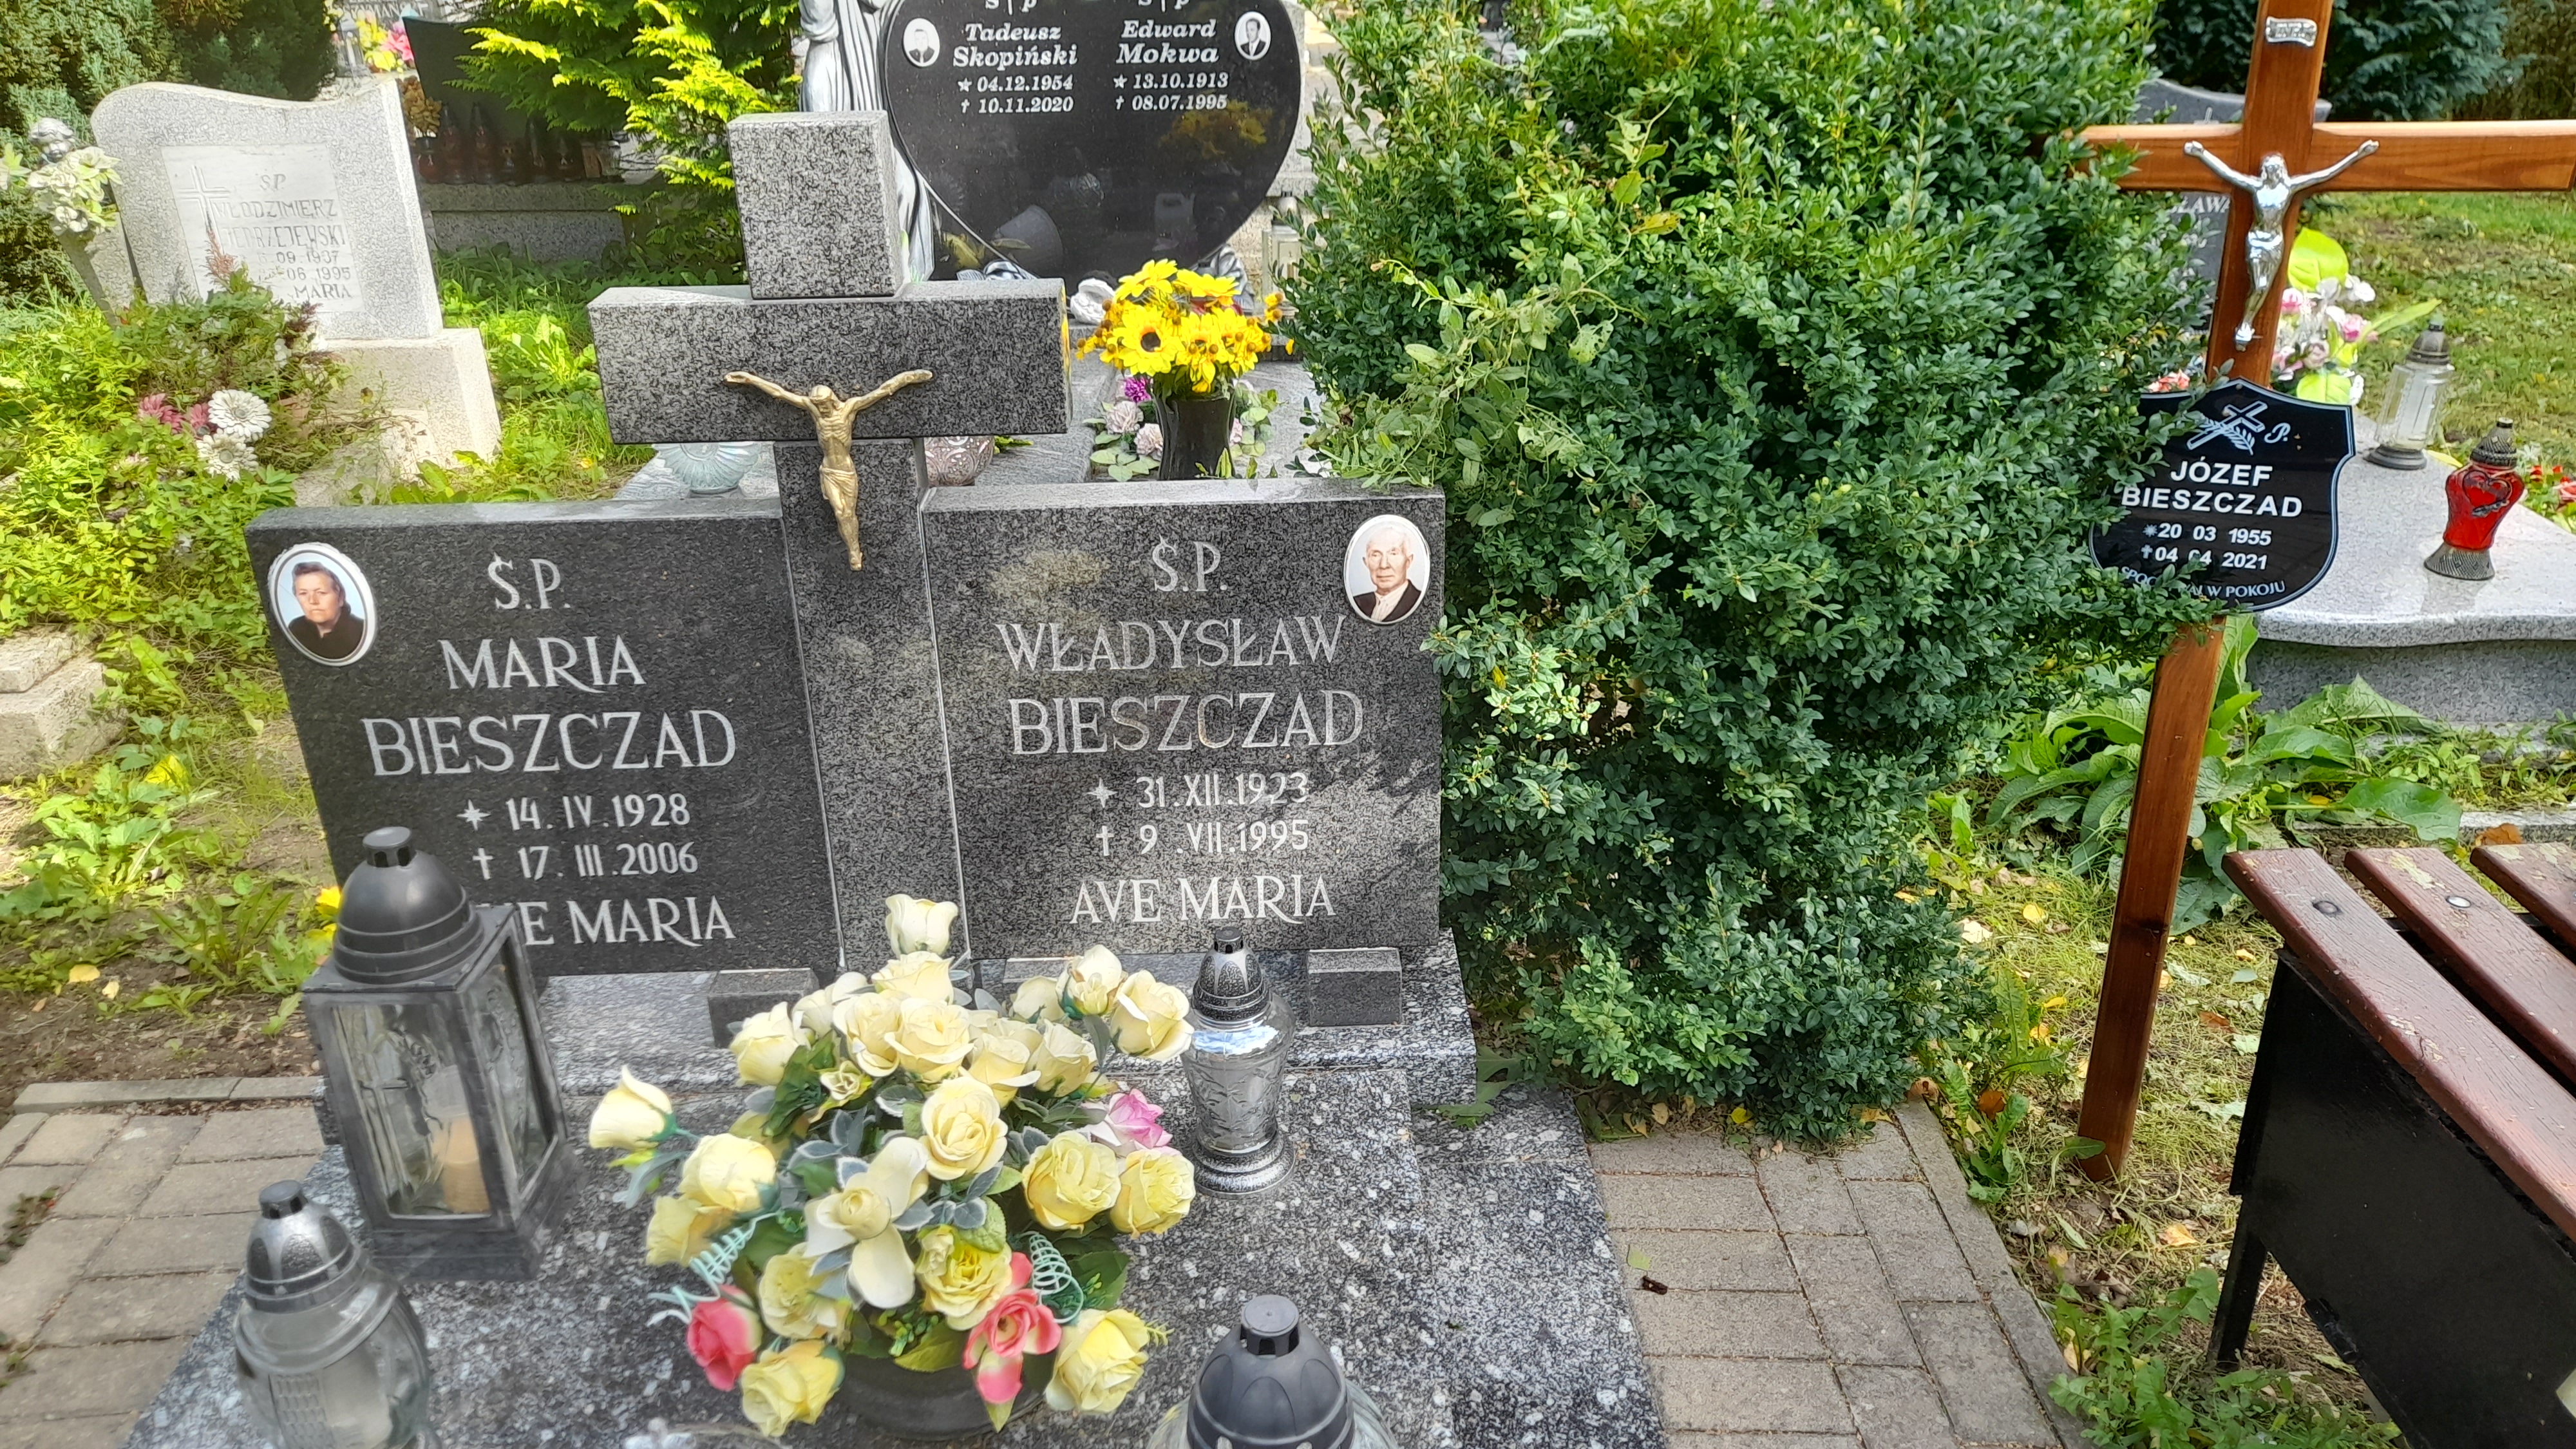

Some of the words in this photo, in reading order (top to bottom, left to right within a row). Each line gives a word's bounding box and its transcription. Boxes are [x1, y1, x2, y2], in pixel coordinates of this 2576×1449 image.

[965, 23, 1061, 42] Tadeusz
[1121, 18, 1217, 38] Edward
[952, 44, 1078, 71] Skopiński
[1115, 43, 1219, 64] Mokwa
[977, 74, 1074, 92] 04.12.1954
[1133, 73, 1229, 90] 13.10.1913
[978, 96, 1074, 113] 10.11.2020
[1132, 93, 1227, 111] 08.07.1995
[294, 283, 352, 299] MARIA
[2170, 456, 2273, 486] JÓZEF
[2121, 487, 2302, 517] BIESZCZAD
[2157, 523, 2182, 539] 20
[2193, 526, 2217, 541] 03
[2228, 528, 2272, 545] 1955
[1152, 533, 1227, 592] Ś.P.
[2155, 547, 2178, 562] 04
[2222, 552, 2268, 570] 2021
[488, 552, 571, 609] Ś.P.
[2207, 585, 2222, 597] W
[2226, 580, 2286, 598] POKOJU
[994, 614, 1346, 672] WŁADYSŁAW
[439, 635, 646, 692] MARIA
[1008, 690, 1363, 754] BIESZCZAD
[361, 710, 736, 776] BIESZCZAD
[1070, 878, 1160, 924] AVE
[1180, 874, 1337, 925] MARIA
[567, 895, 737, 947] MARIA
